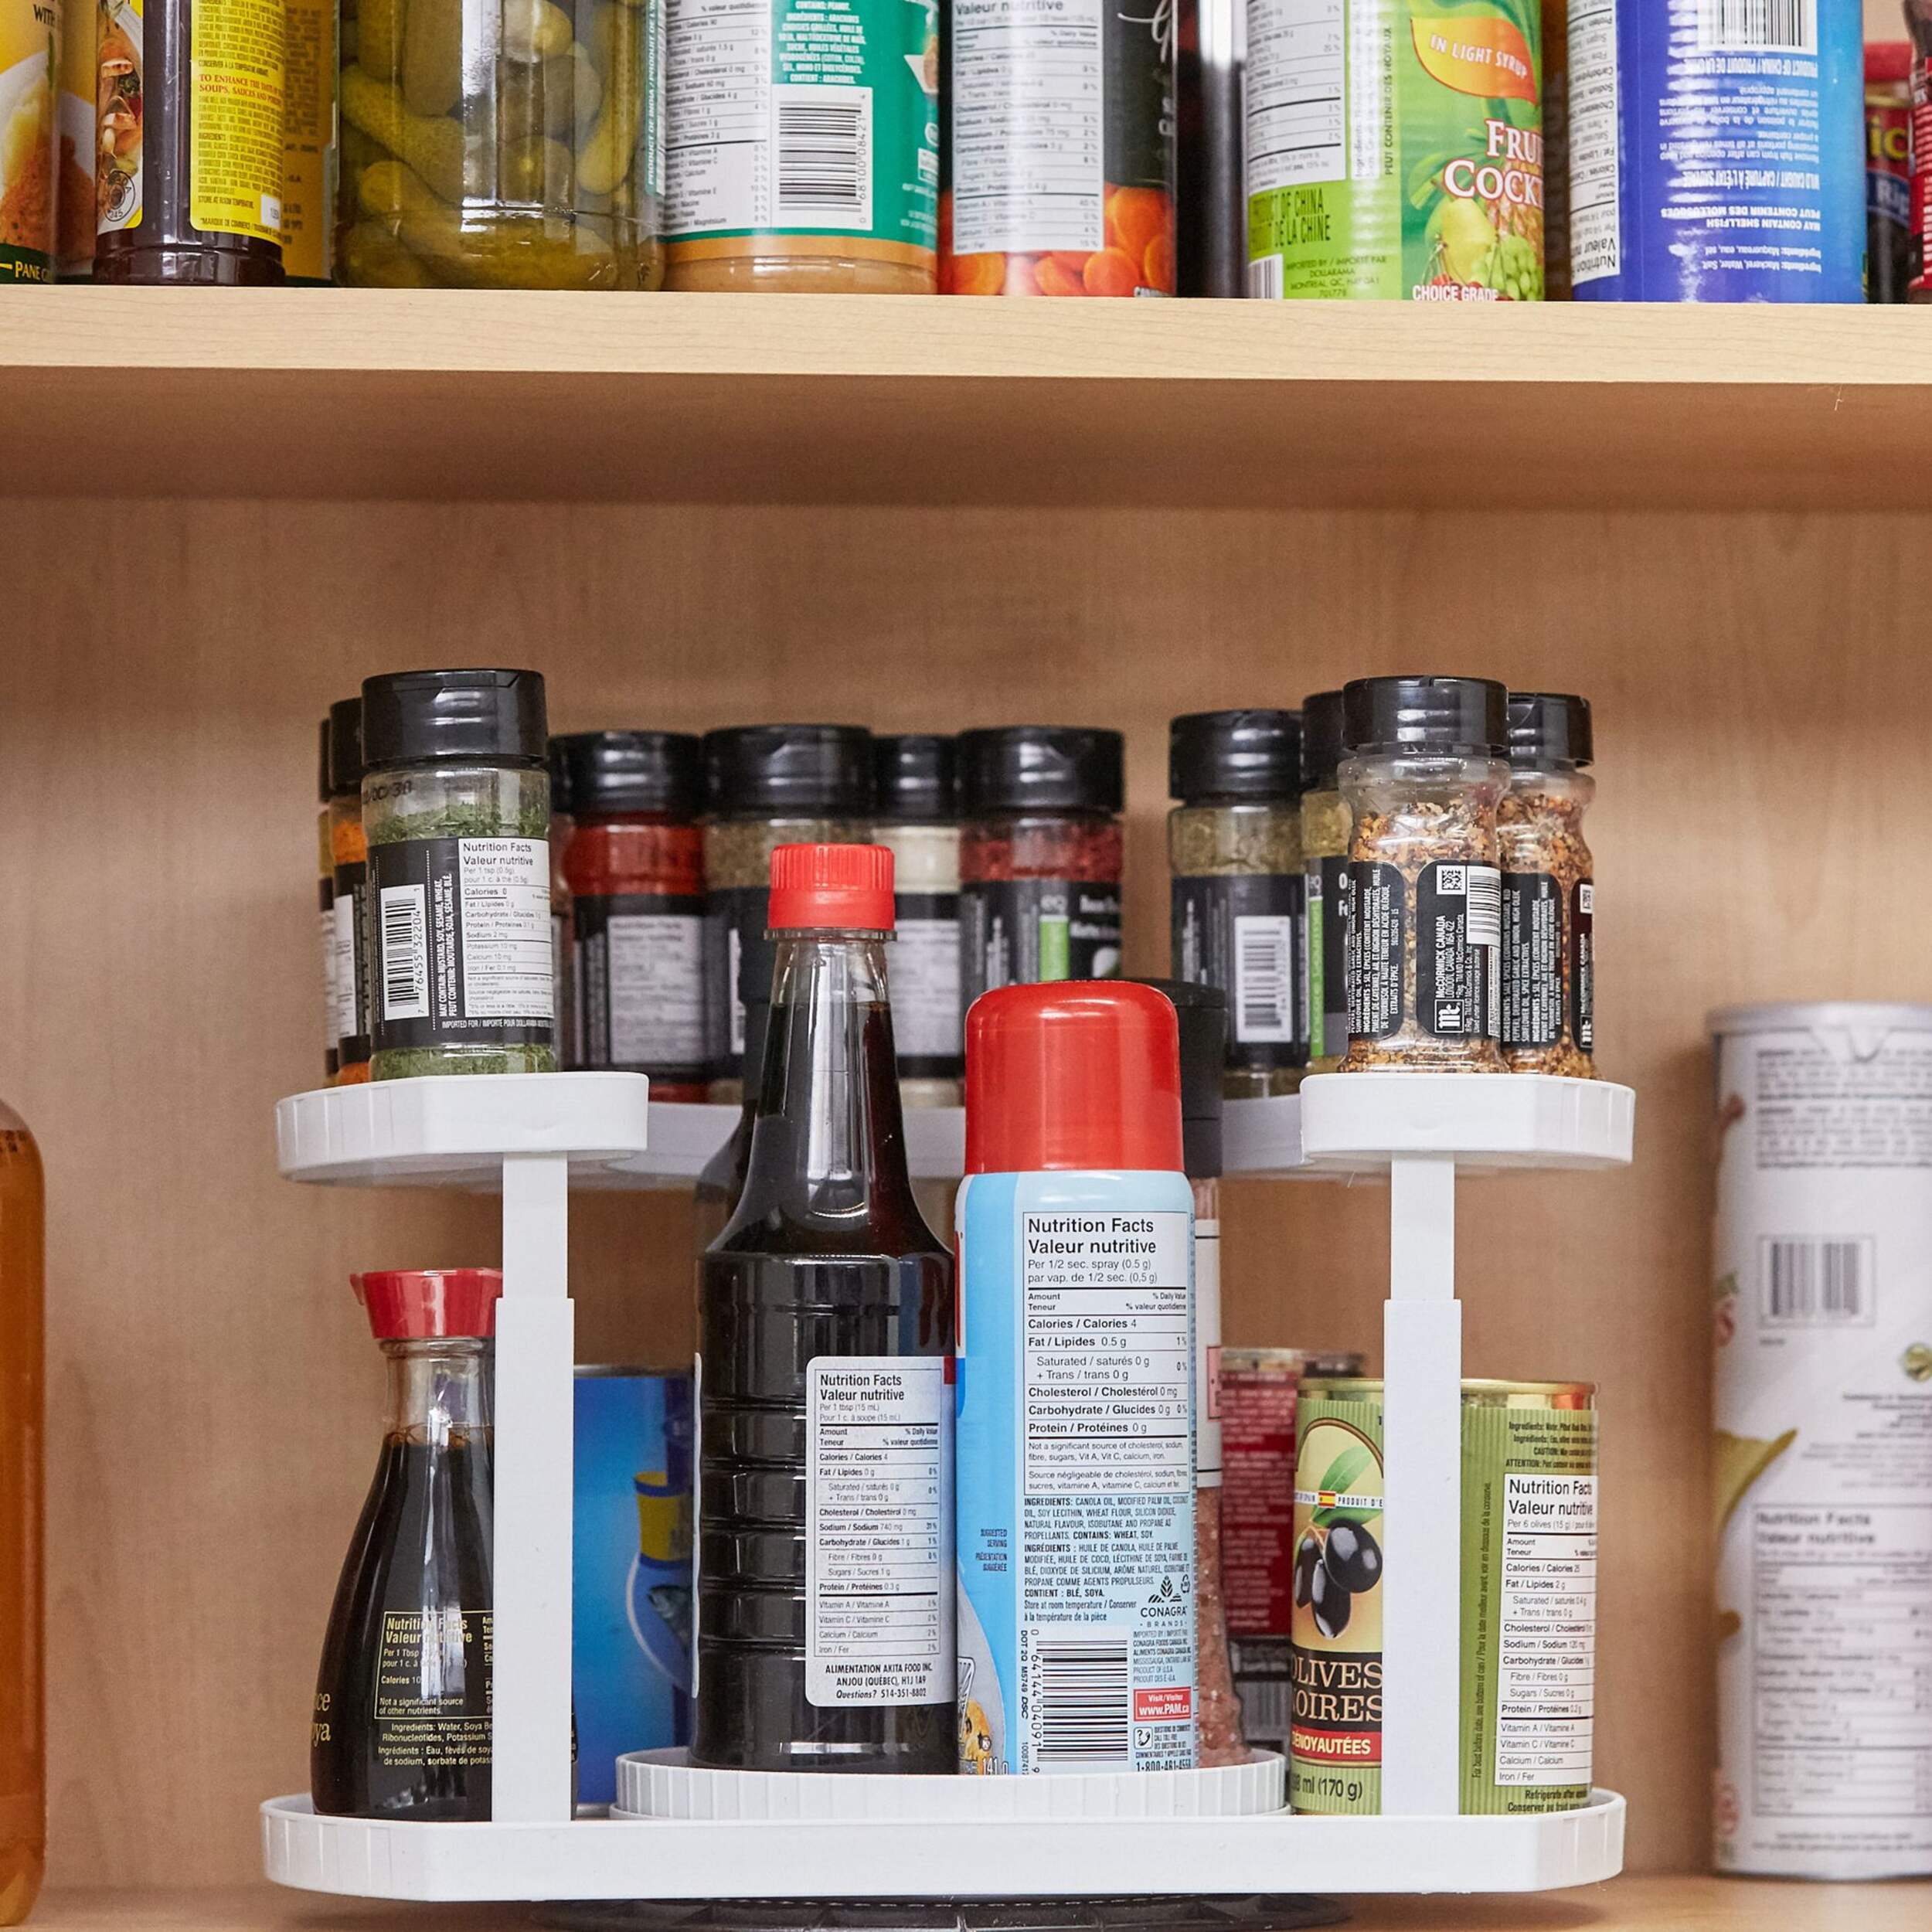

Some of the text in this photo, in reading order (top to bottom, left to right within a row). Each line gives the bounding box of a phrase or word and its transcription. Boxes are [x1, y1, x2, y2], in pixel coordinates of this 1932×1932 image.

[1430, 34, 1447, 53] IN
[1451, 40, 1492, 64] LIGHT
[1485, 118, 1543, 165] FRUI
[1384, 151, 1393, 175] PEUT
[1444, 158, 1543, 207] COCKT
[1412, 284, 1460, 301] CHOICE
[463, 842, 532, 853] Nutrition Facts
[463, 855, 534, 866] Valeur nutritive
[464, 887, 498, 896] Calories
[412, 910, 424, 992] 76455 32204
[1435, 915, 1445, 998] McCORMICK CANADA
[1028, 1217, 1154, 1233] Nutrition Facts
[1028, 1239, 1157, 1253] Valeur nutritive
[1028, 1260, 1045, 1269] Per
[1049, 1260, 1064, 1269] 1/2
[1067, 1260, 1090, 1269] sec.
[1091, 1261, 1119, 1270] spray
[1028, 1275, 1045, 1284] par
[1047, 1274, 1068, 1284] vap.
[1071, 1273, 1084, 1282] de
[1089, 1273, 1104, 1282] 1/2
[1028, 1319, 1128, 1328] Calories Calories
[1029, 1338, 1046, 1347] Fat
[1055, 1337, 1095, 1347] Lipides
[1037, 1355, 1133, 1366] Saturated saturés
[1046, 1370, 1110, 1379] Trans trans
[820, 1375, 902, 1386] Nutrition Facts
[820, 1389, 904, 1400] Valeur nutritive
[1029, 1386, 1158, 1397] Cholesterol Cholestérol
[1029, 1404, 1155, 1416] Carbohydrate Glucides
[1029, 1423, 1128, 1433] Protein Protéines
[838, 1468, 862, 1477] Lipides
[1509, 1479, 1570, 1495] Nutrition
[1024, 1498, 1102, 1506] INGREDIENTS: CANOLA
[1338, 1497, 1366, 1506] PRODUIT
[1509, 1499, 1555, 1515] Valeur
[1073, 1531, 1111, 1539] CONTAINS:
[1527, 1580, 1554, 1589] Lipides
[1024, 1588, 1059, 1597] CONTIENT
[1024, 1600, 1039, 1609] Store
[1066, 1600, 1102, 1611] temperature
[1140, 1607, 1187, 1617] CONAGRA
[1504, 1624, 1550, 1633] Cholesterol
[386, 1631, 421, 1644] Valeur
[1503, 1640, 1536, 1648] Sodium
[1503, 1656, 1556, 1665] Carbohydrate
[825, 1665, 881, 1674] ALIMENTATION
[883, 1664, 903, 1672] AKITA
[381, 1675, 410, 1684] Calories
[836, 1677, 862, 1686] ANJOU
[836, 1689, 927, 1699] Questions? 514-351-8802
[1031, 1655, 1042, 1747] 64144 04091
[1293, 1689, 1382, 1722] OIRES
[1139, 1703, 1190, 1716] www.PAM.ca
[1502, 1704, 1532, 1713] Protein
[391, 1722, 482, 1733] Ingredients: Water, Soya
[447, 1733, 486, 1742] Potassium
[378, 1745, 419, 1756] Ingrédients
[427, 1756, 457, 1765] sorbate
[1318, 1777, 1344, 1798] (170
[1347, 1781, 1362, 1801] g)
